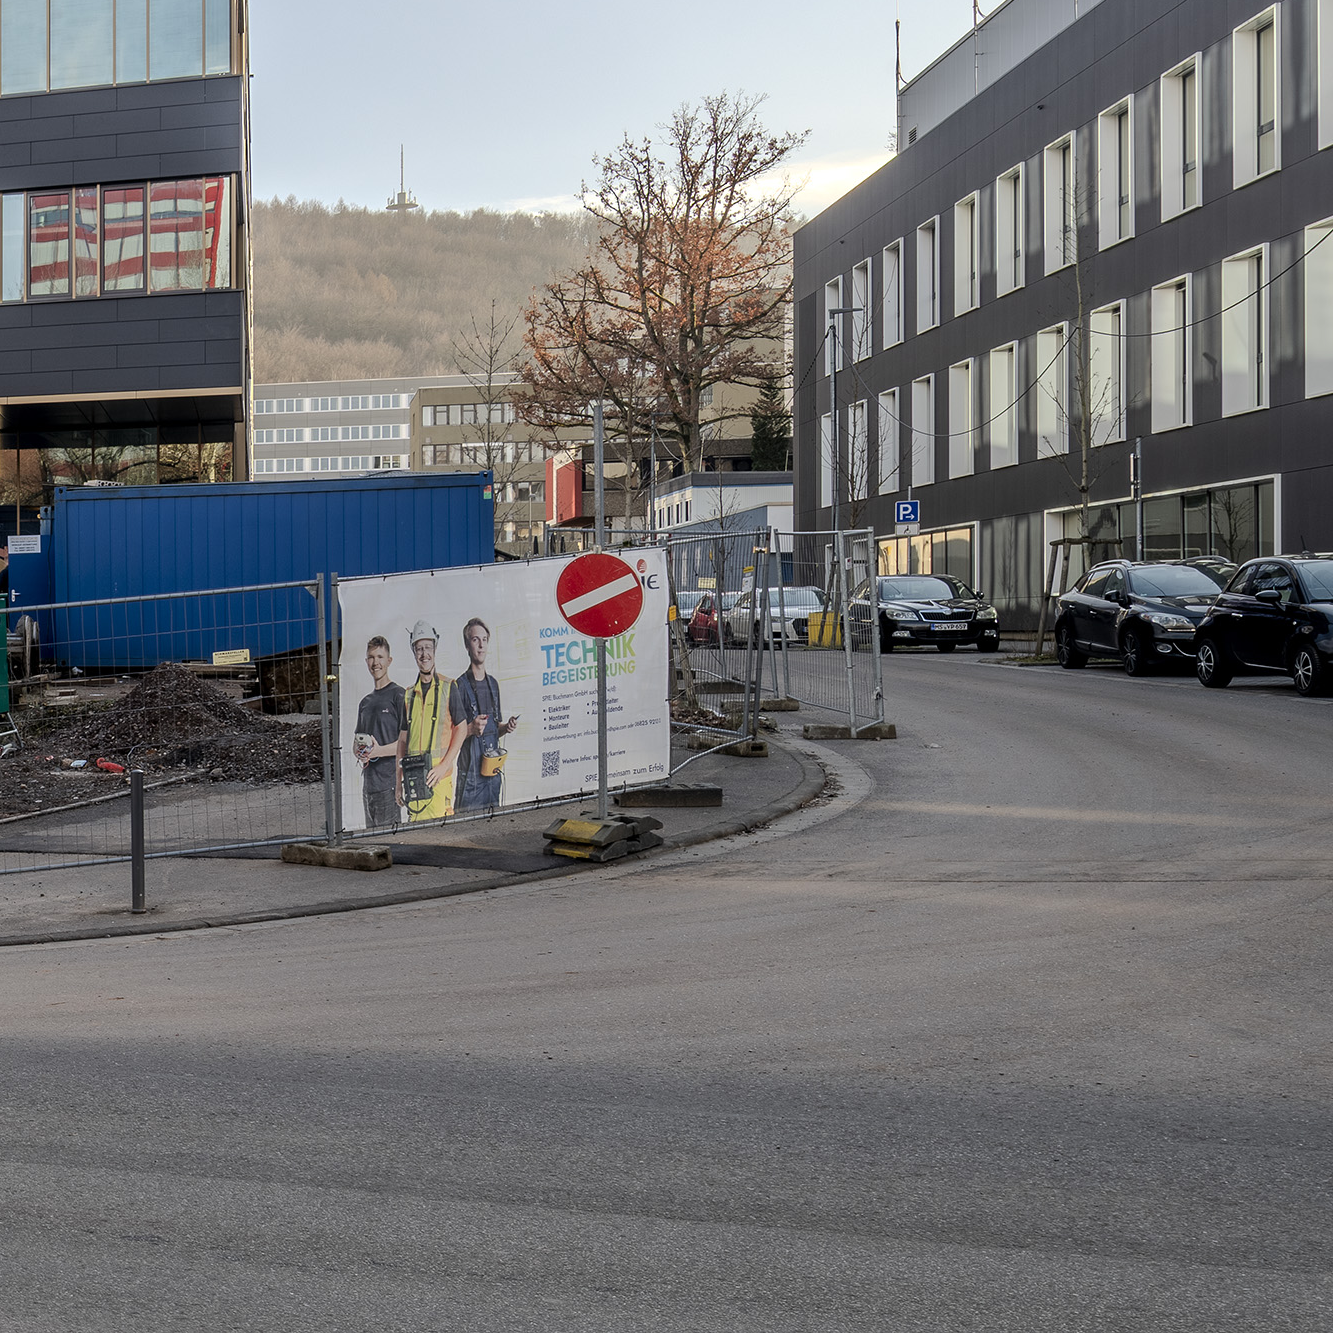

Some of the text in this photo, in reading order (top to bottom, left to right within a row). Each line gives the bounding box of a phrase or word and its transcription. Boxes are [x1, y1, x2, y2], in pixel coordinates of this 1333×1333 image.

[899, 504, 913, 521] P
[539, 626, 569, 638] KOMM
[540, 634, 636, 669] TECHNIK
[548, 705, 571, 713] Elektriker
[548, 714, 570, 722] Monteure
[633, 767, 647, 775] zum
[648, 762, 664, 773] Erfolg
